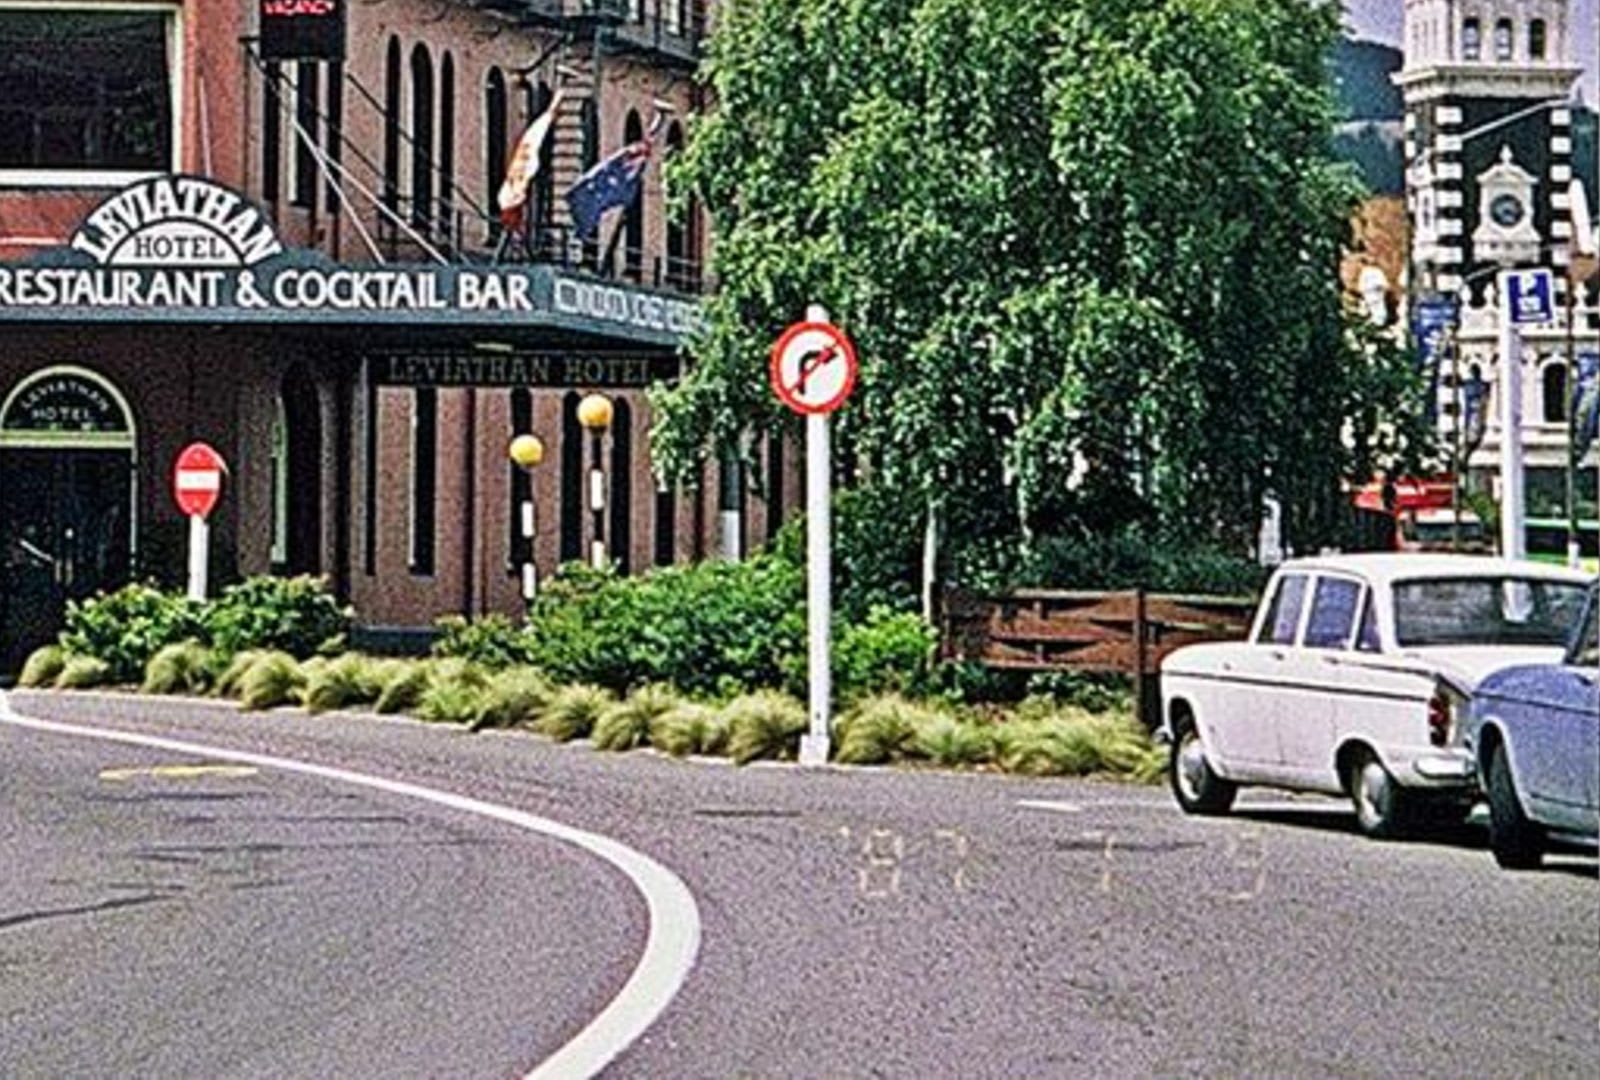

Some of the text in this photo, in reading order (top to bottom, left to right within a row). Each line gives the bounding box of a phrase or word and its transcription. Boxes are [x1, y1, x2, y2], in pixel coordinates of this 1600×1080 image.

[73, 179, 282, 266] LEVIATHAN
[134, 235, 225, 259] HOTEL
[236, 271, 267, 308] &
[274, 271, 446, 310] COCKTAIL
[458, 274, 533, 311] BAR
[388, 356, 649, 384] LEVIATHAN HOTEL
[21, 380, 110, 412] LEVIATHAN
[32, 406, 91, 420] HOTEL
